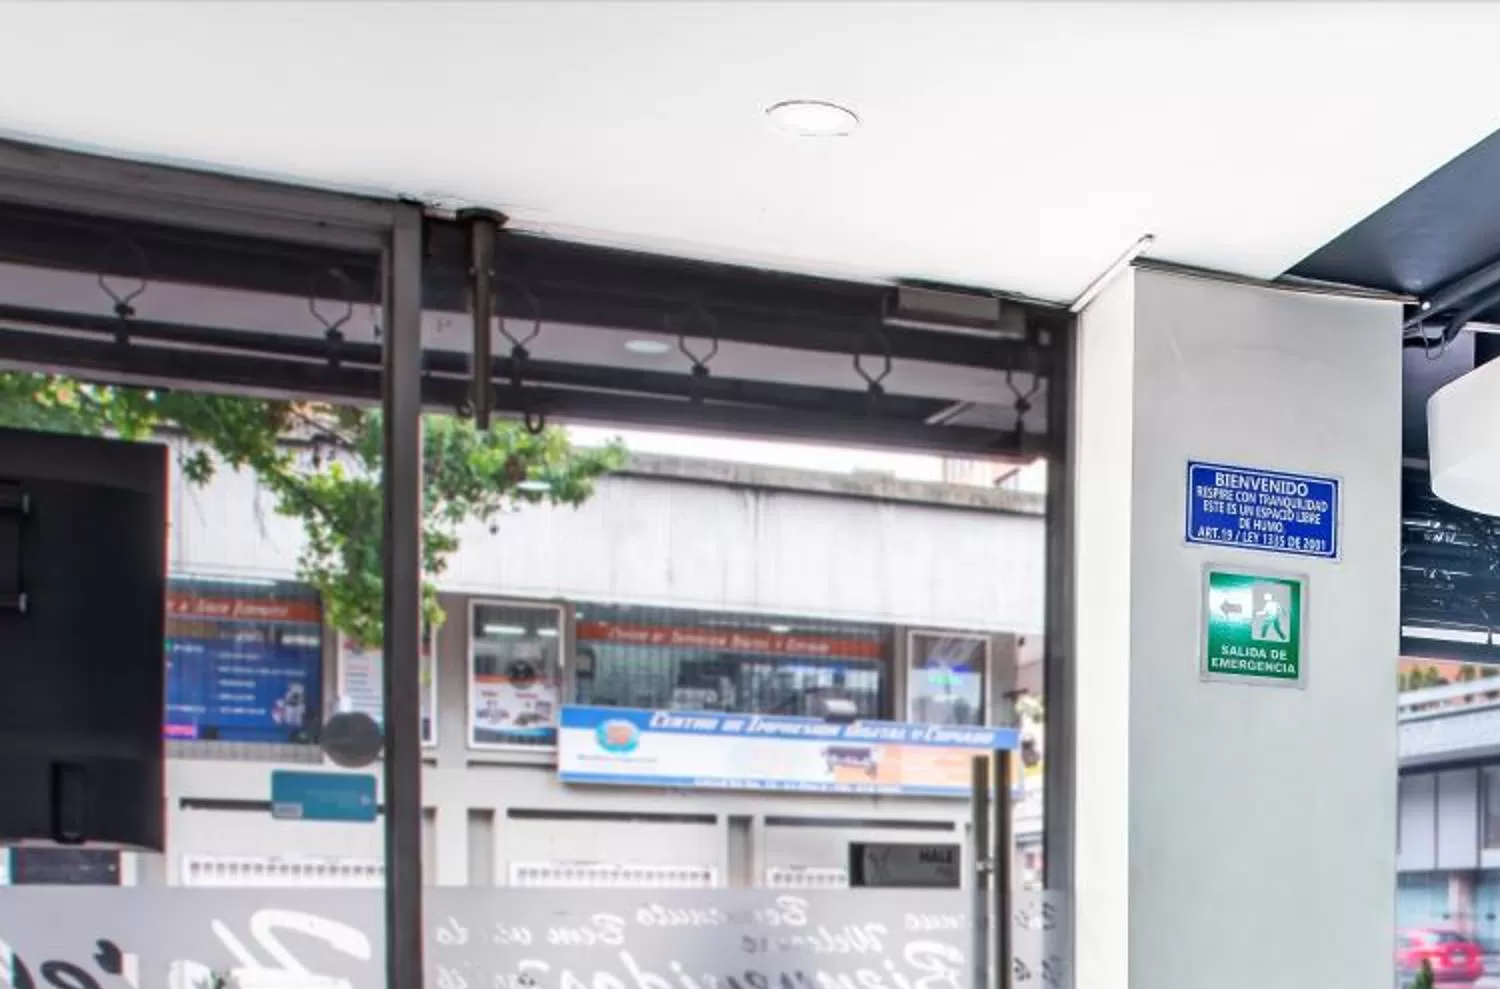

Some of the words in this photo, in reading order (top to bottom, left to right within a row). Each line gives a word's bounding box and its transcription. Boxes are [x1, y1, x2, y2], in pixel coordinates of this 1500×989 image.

[1215, 471, 1309, 497] BIENVENIDO
[1235, 491, 1257, 504] CON
[1259, 493, 1329, 513] TRANQUILIDAD
[1203, 500, 1225, 513] ESTE
[1226, 503, 1237, 515] ES
[1239, 504, 1254, 517] UN
[1255, 506, 1295, 522] ESPACIO
[1295, 510, 1322, 525] LIBRE
[1239, 517, 1251, 530] DE
[1243, 532, 1260, 543] LEY
[1287, 535, 1300, 549] DE
[1220, 644, 1268, 659] SALIDA
[1270, 649, 1288, 661] DE
[1210, 657, 1296, 674] EMERGENCIA
